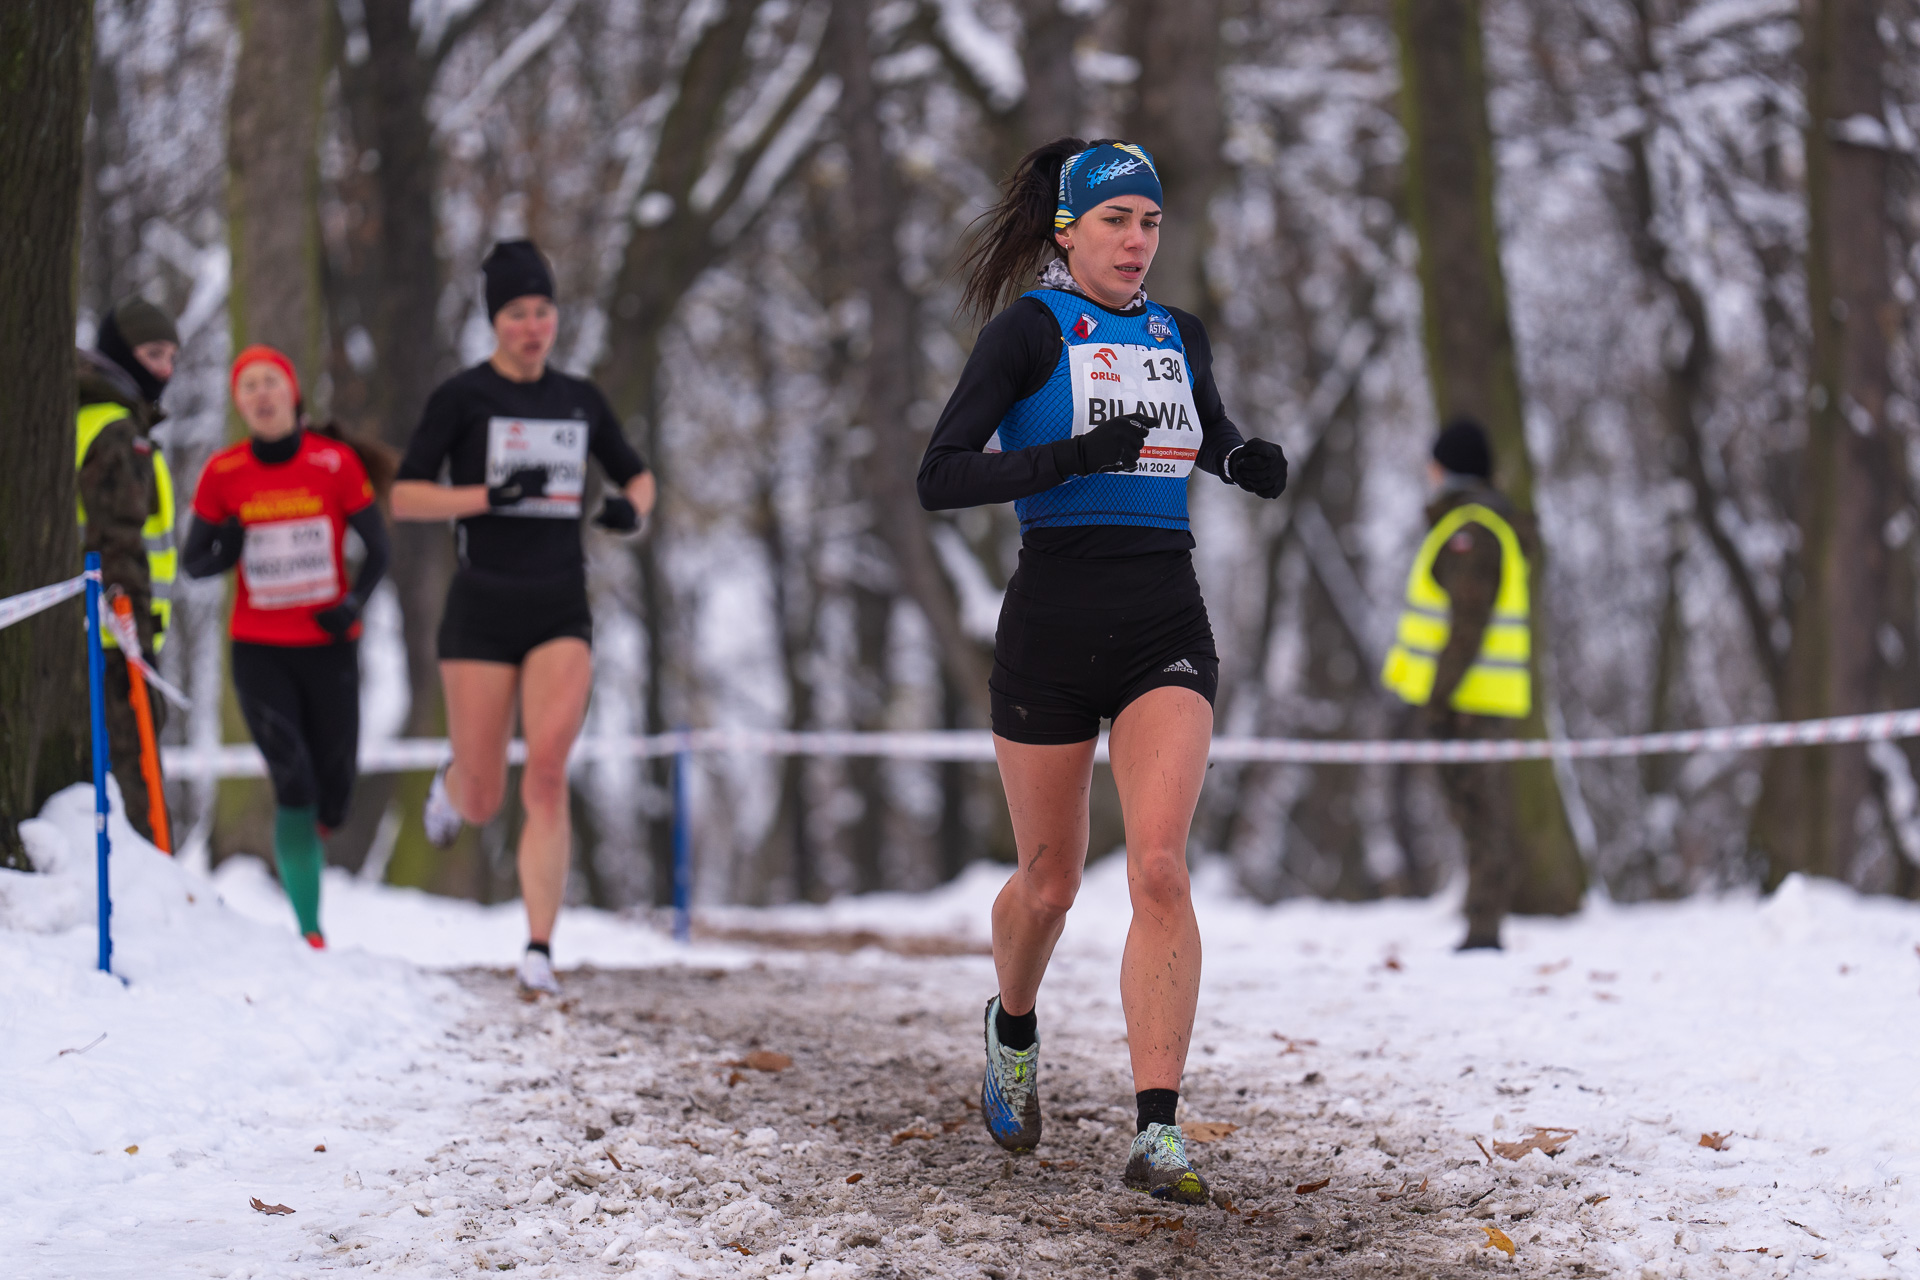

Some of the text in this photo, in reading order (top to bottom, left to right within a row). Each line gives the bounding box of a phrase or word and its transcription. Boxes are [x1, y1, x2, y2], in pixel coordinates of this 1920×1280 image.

[1149, 324, 1171, 335] ASTRA
[1143, 357, 1183, 384] 138
[1090, 371, 1121, 383] ORLEN
[553, 428, 577, 448] 43
[1139, 462, 1176, 473] M 2024
[1163, 665, 1198, 675] adidas
